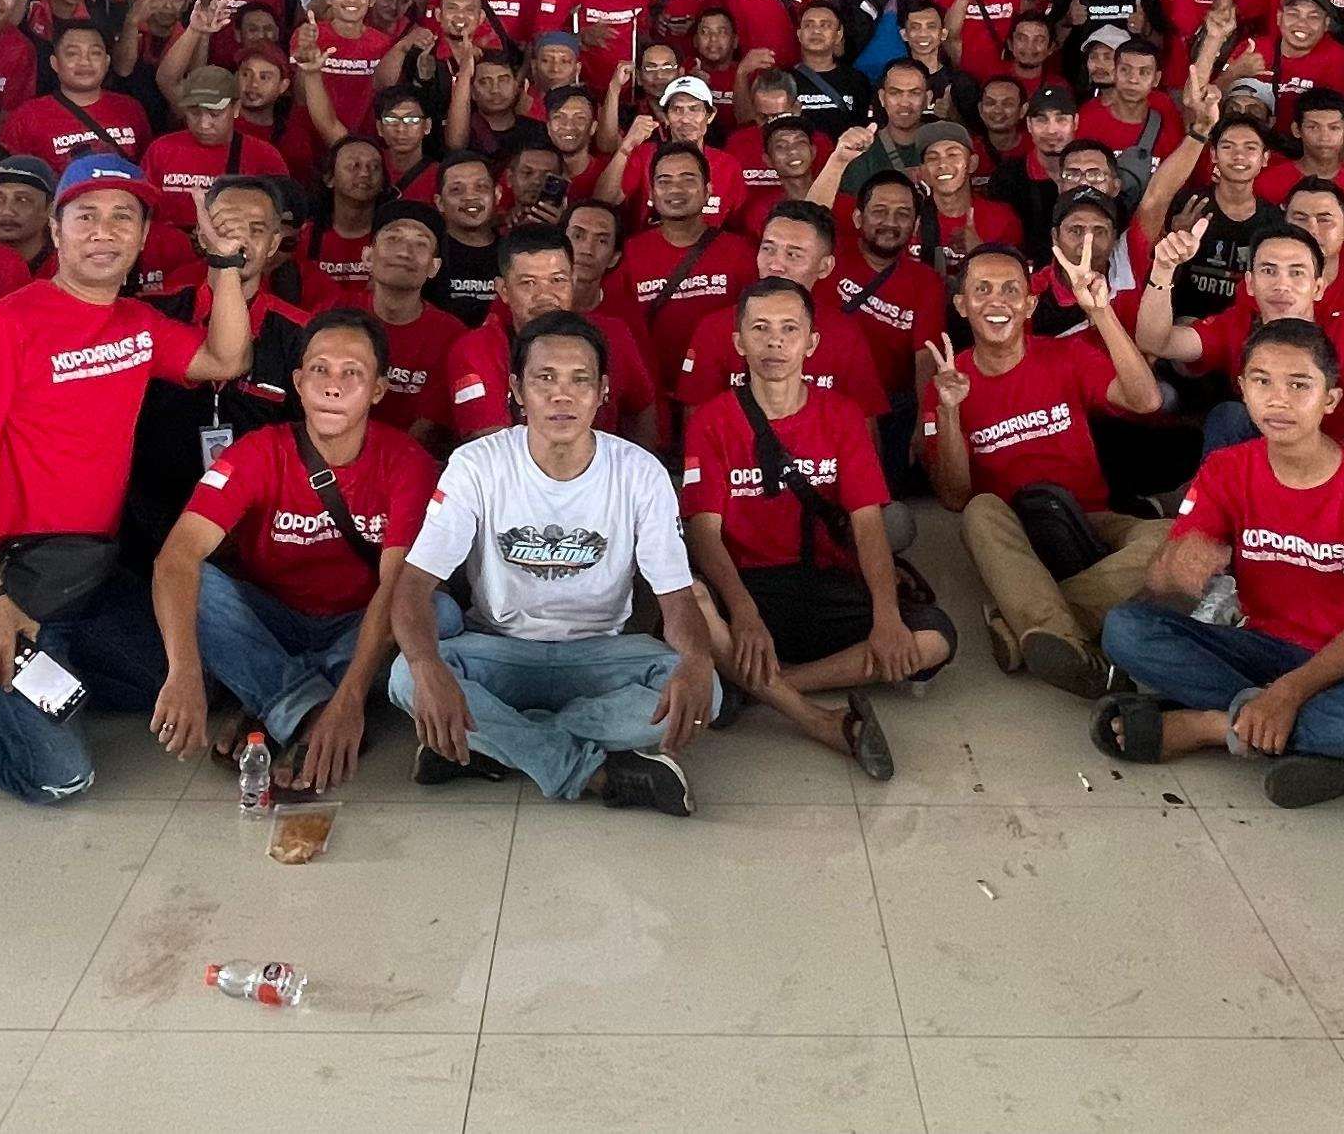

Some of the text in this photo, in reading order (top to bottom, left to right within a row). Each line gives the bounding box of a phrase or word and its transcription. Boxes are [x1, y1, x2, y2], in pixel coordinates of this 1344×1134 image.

[51, 330, 154, 372] KOPDARNAS #6
[1050, 403, 1071, 421] #6
[509, 541, 599, 564] mekanik
